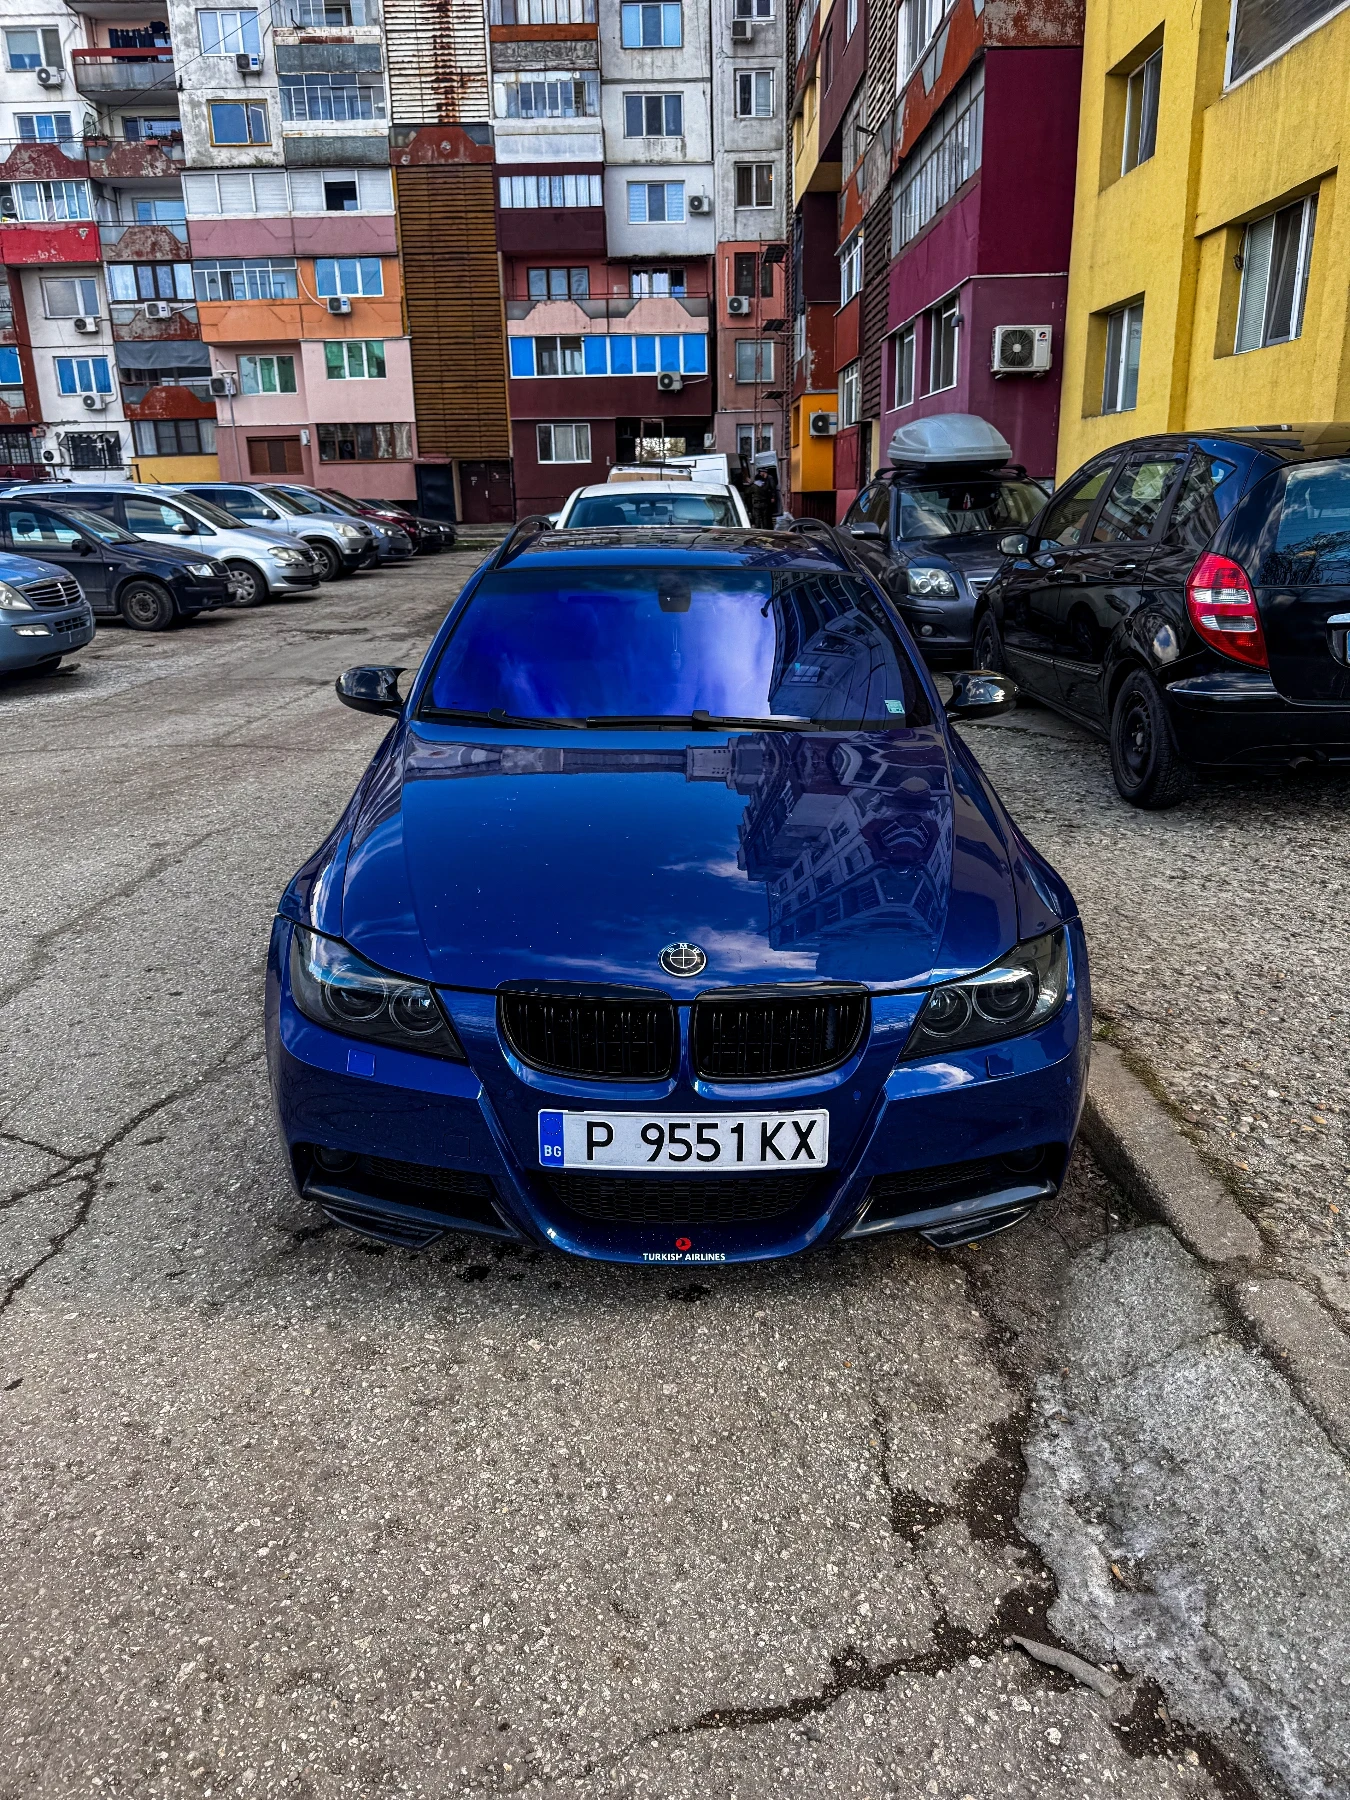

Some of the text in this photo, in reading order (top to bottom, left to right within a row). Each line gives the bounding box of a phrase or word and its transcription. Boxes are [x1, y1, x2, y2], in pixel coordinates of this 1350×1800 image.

[586, 1119, 818, 1162] P 9551 KX
[543, 1144, 562, 1158] BG
[642, 1252, 726, 1261] TURKISH AIRLINES
